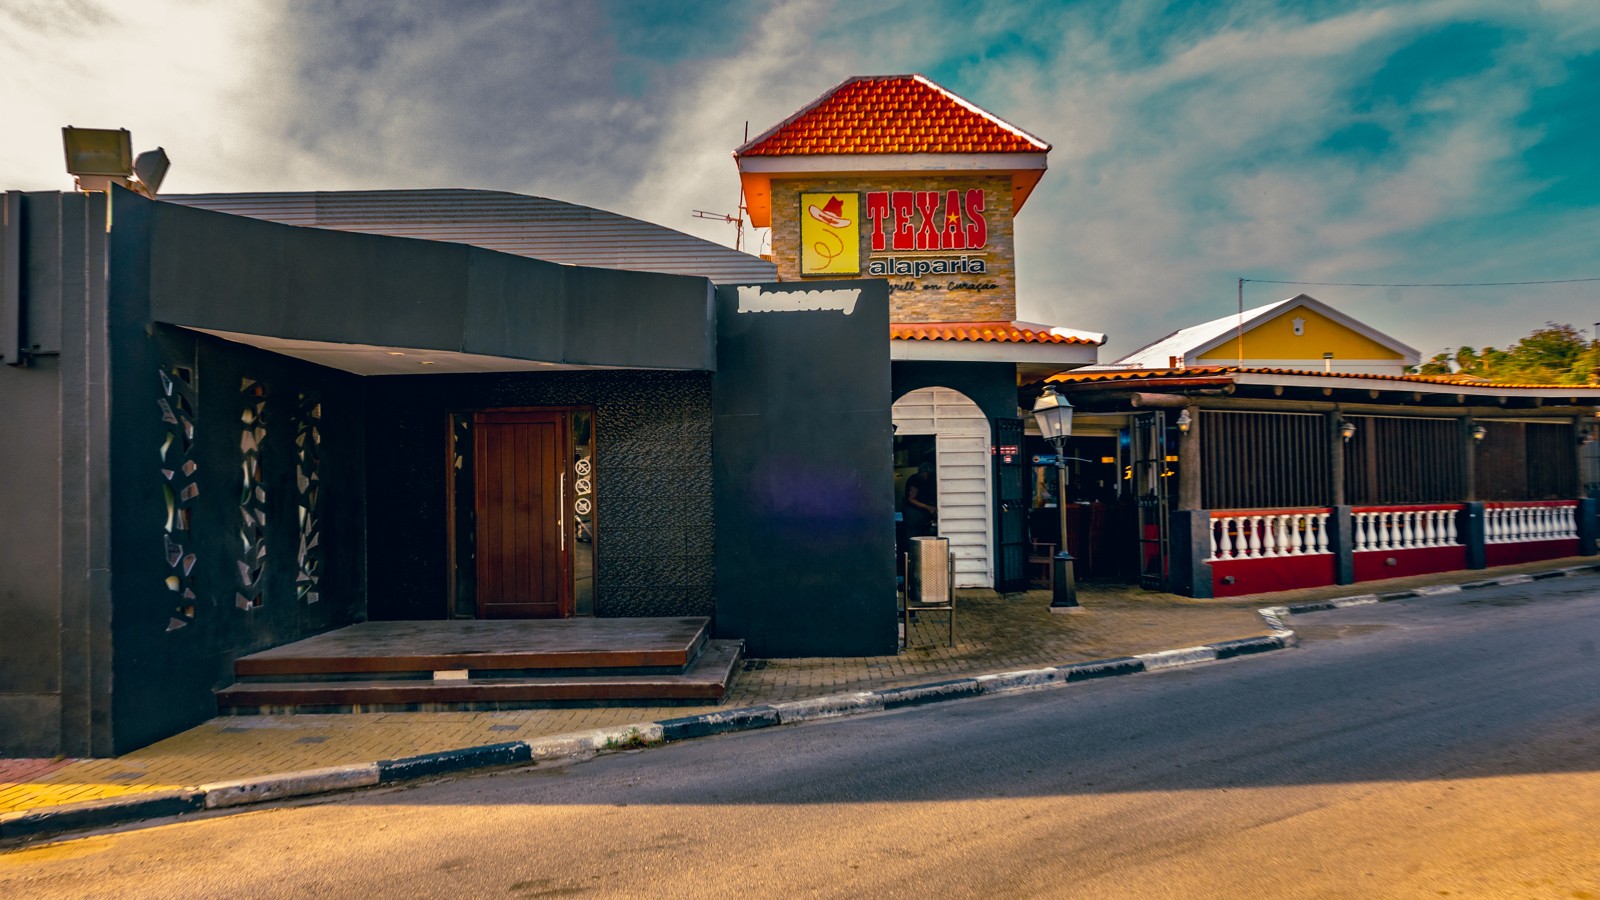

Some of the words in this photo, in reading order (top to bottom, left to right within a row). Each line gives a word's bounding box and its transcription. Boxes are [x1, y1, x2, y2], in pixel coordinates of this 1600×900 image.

[866, 188, 987, 251] TEXAS
[869, 255, 986, 278] alaparia
[947, 281, 999, 292] Curaçao
